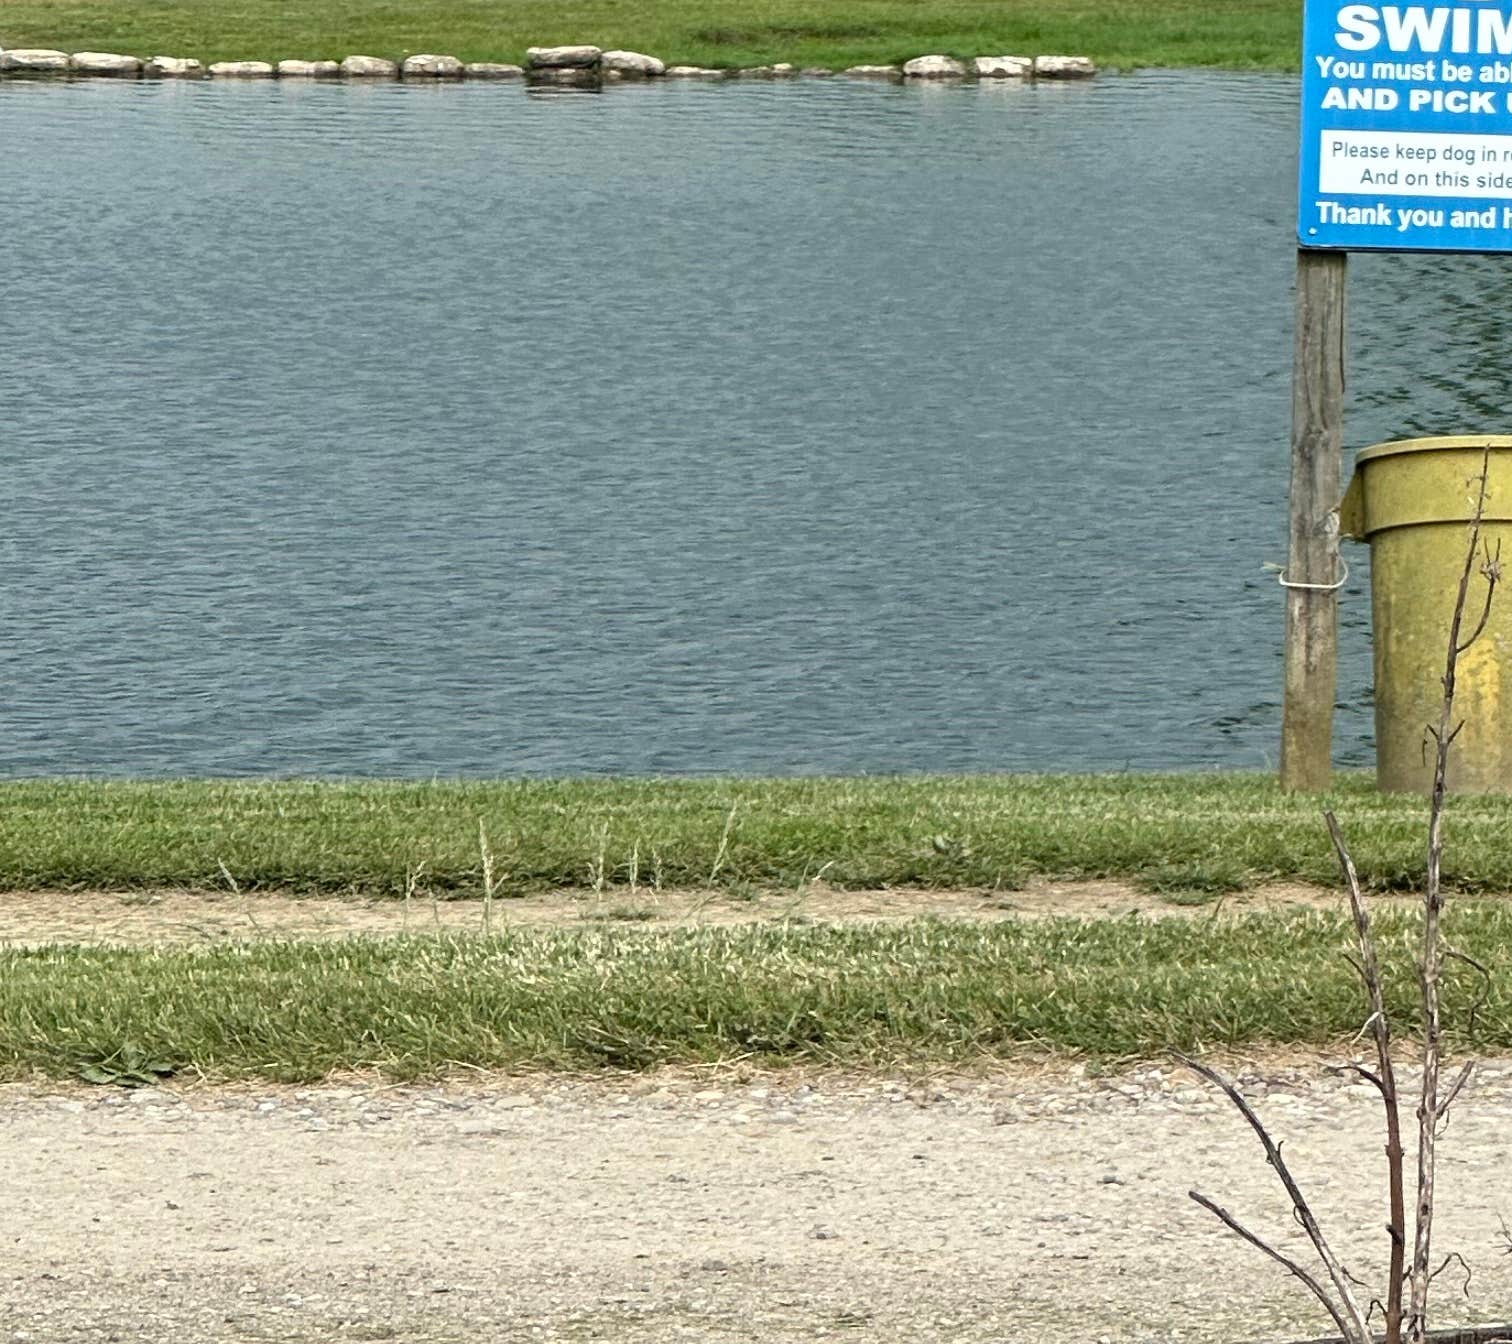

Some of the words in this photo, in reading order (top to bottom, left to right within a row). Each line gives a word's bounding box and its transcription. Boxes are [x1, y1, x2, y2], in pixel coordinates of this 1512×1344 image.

[1315, 56, 1365, 79] You
[1372, 60, 1436, 82] must
[1442, 60, 1473, 83] be
[1320, 86, 1399, 111] AND
[1409, 89, 1497, 114] PICK
[1332, 141, 1390, 159] Please
[1396, 143, 1437, 164] keep
[1442, 145, 1475, 165] dog
[1481, 145, 1497, 162] in
[1360, 168, 1398, 186] And
[1405, 172, 1429, 186] on
[1435, 171, 1470, 188] this
[1315, 201, 1392, 226] Thank
[1397, 208, 1444, 232] you
[1450, 207, 1497, 229] and
